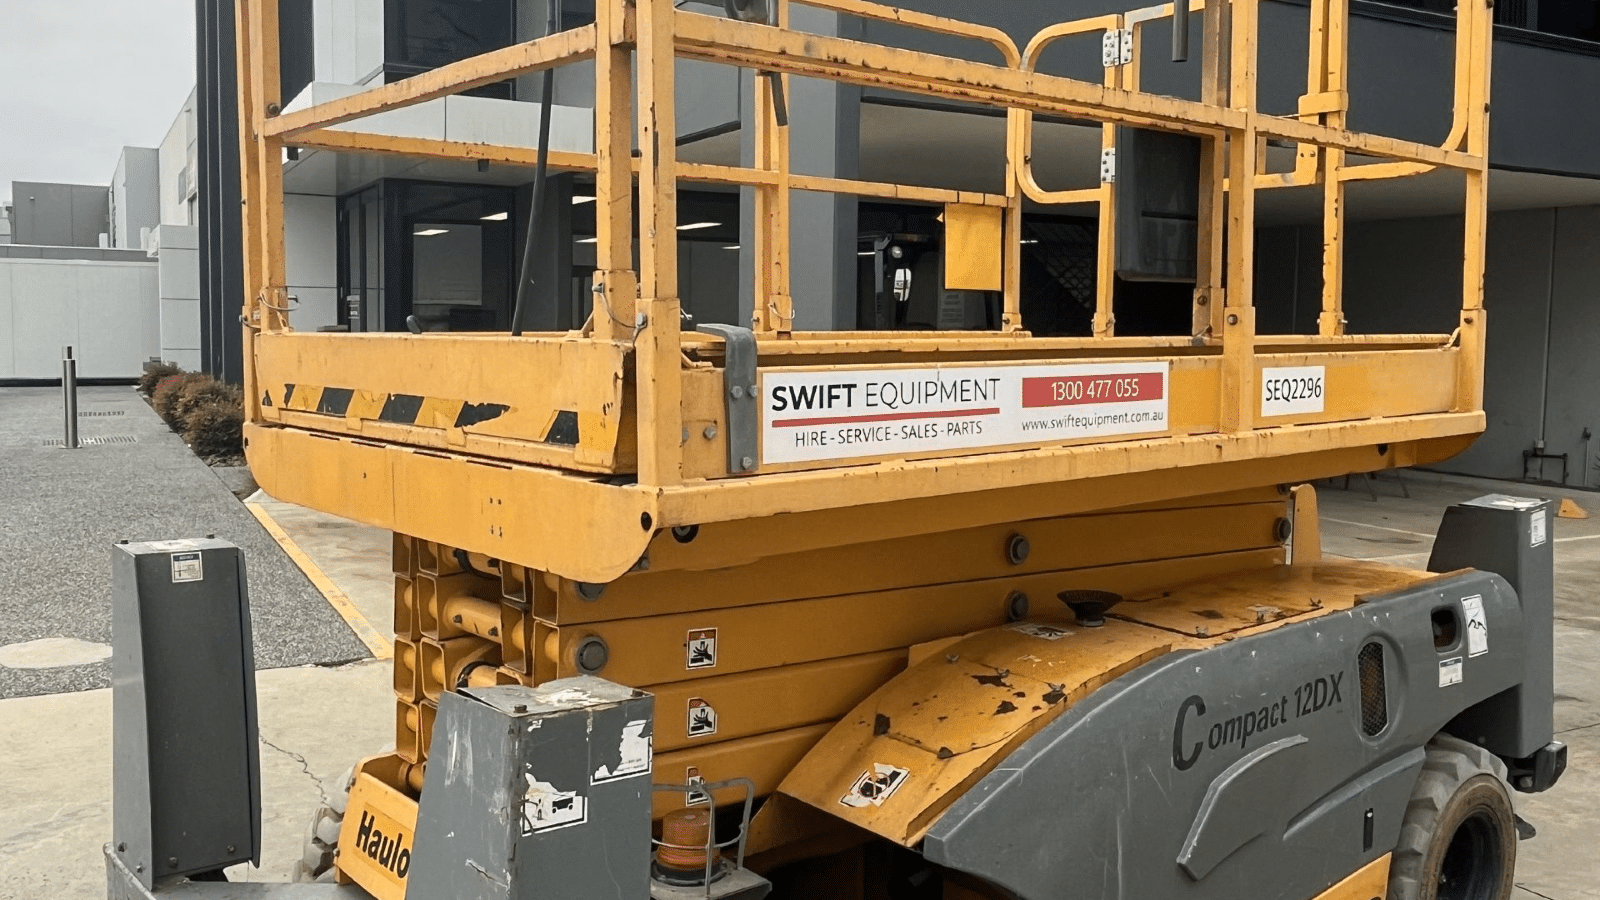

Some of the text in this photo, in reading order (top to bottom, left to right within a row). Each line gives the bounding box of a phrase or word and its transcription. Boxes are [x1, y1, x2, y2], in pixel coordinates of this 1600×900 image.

[772, 378, 1000, 411] SWIFT EQUIPMENT
[1051, 378, 1139, 401] 1300 477 055
[1265, 377, 1322, 403] SEQ2296
[1021, 410, 1164, 431] www.swiftequipment.com.au
[1172, 671, 1344, 771] Compact 12DX
[355, 809, 411, 879] Haulo
